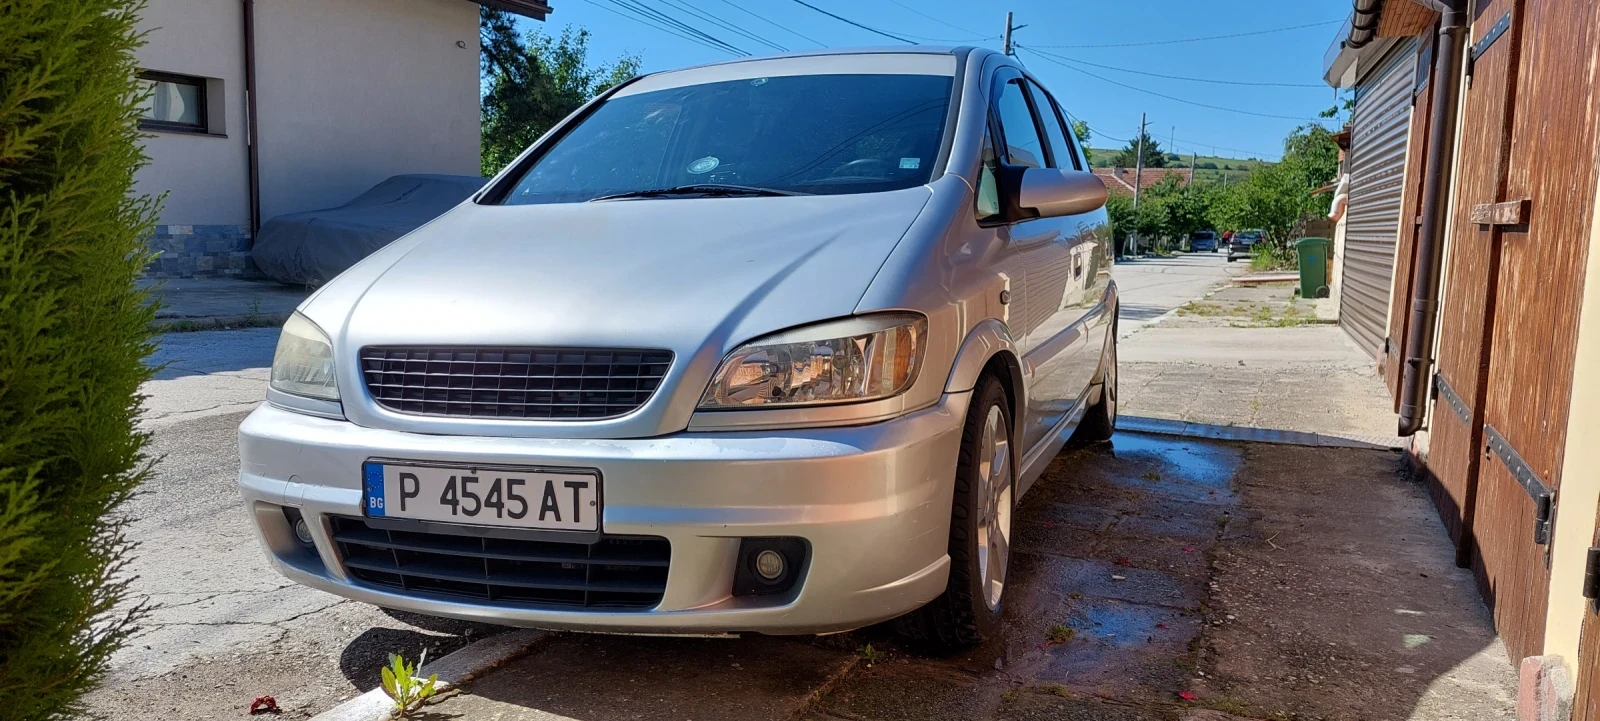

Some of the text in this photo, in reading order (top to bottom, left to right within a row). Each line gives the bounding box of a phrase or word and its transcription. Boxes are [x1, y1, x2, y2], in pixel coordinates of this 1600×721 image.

[370, 496, 384, 509] BG
[399, 472, 589, 523] P 4545 AT
